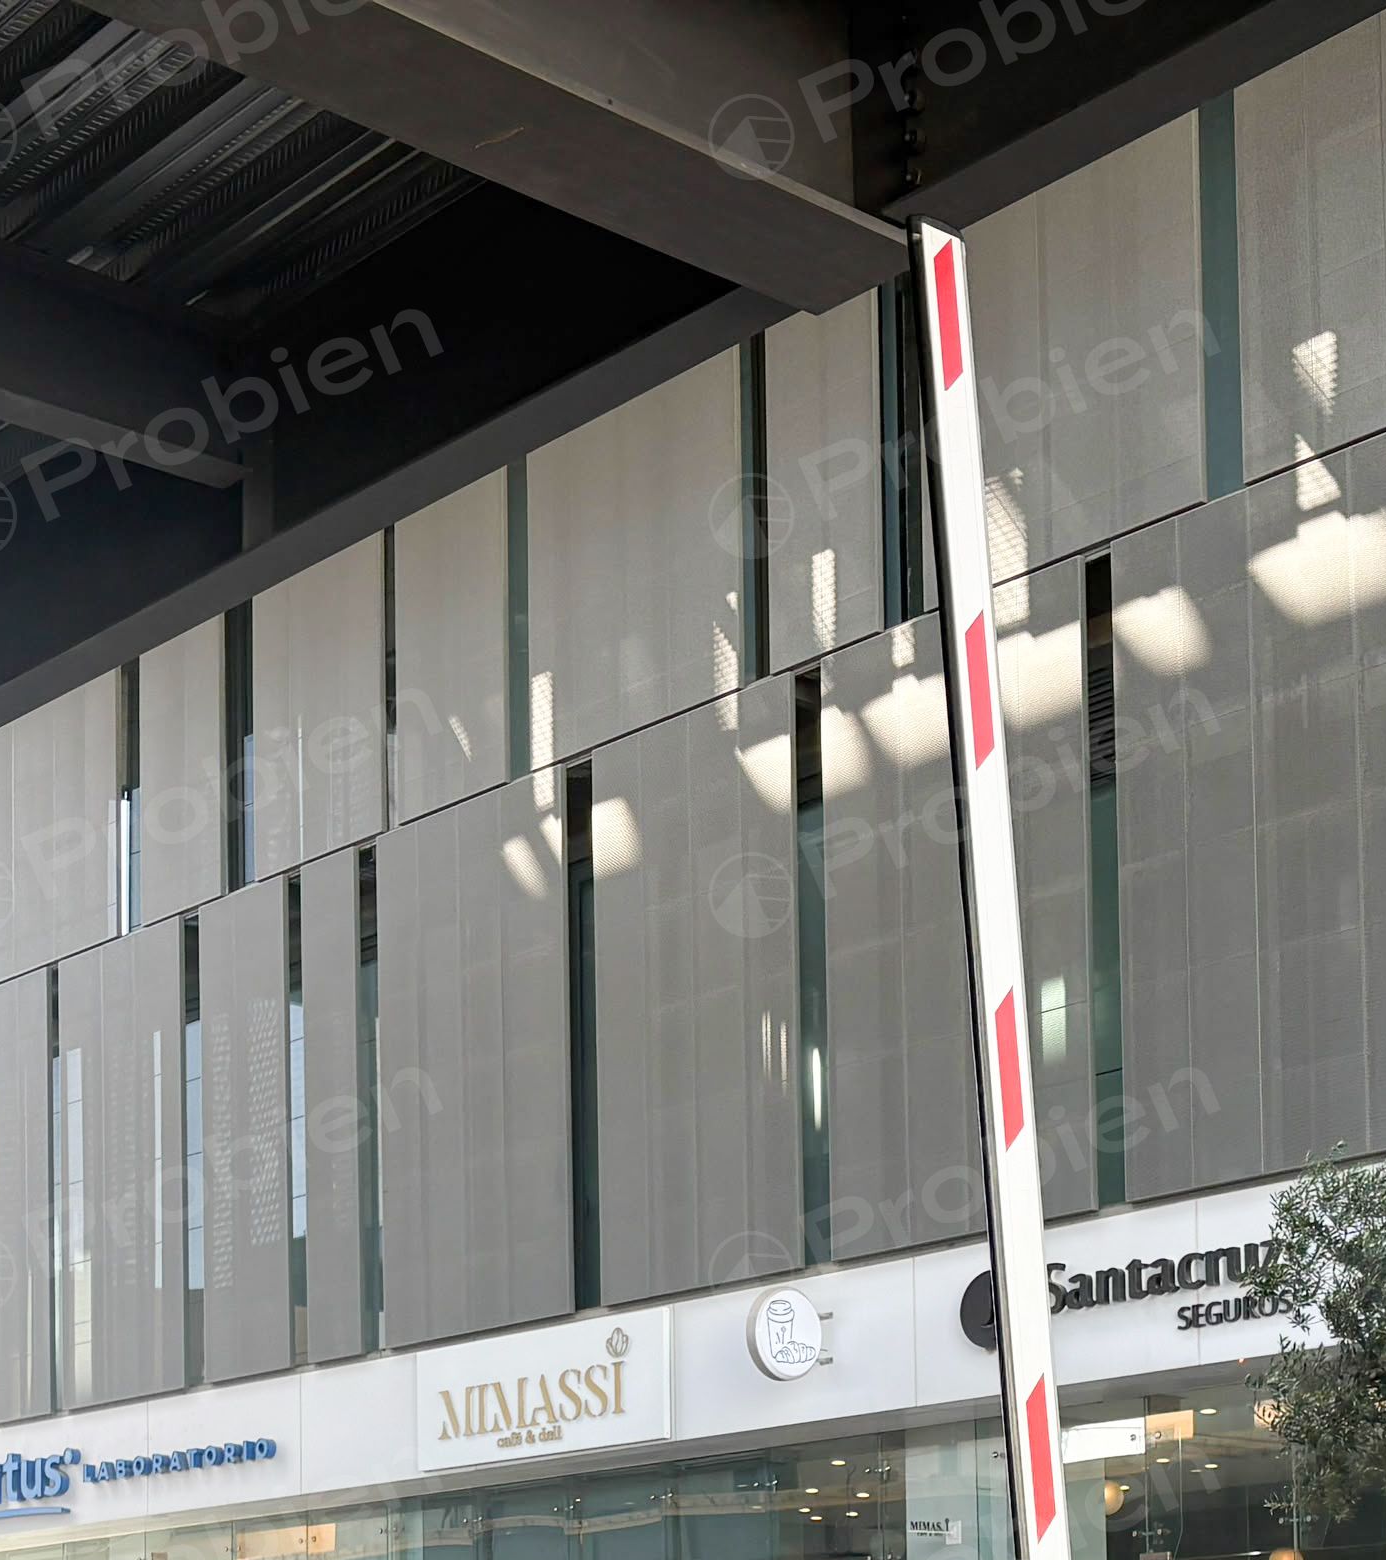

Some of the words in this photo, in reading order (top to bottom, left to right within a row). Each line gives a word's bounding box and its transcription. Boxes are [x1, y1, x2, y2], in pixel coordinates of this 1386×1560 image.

[1047, 1240, 1284, 1315] Santacruz
[1177, 1290, 1293, 1331] SEGUROS
[82, 1438, 277, 1483] LABORATORIO
